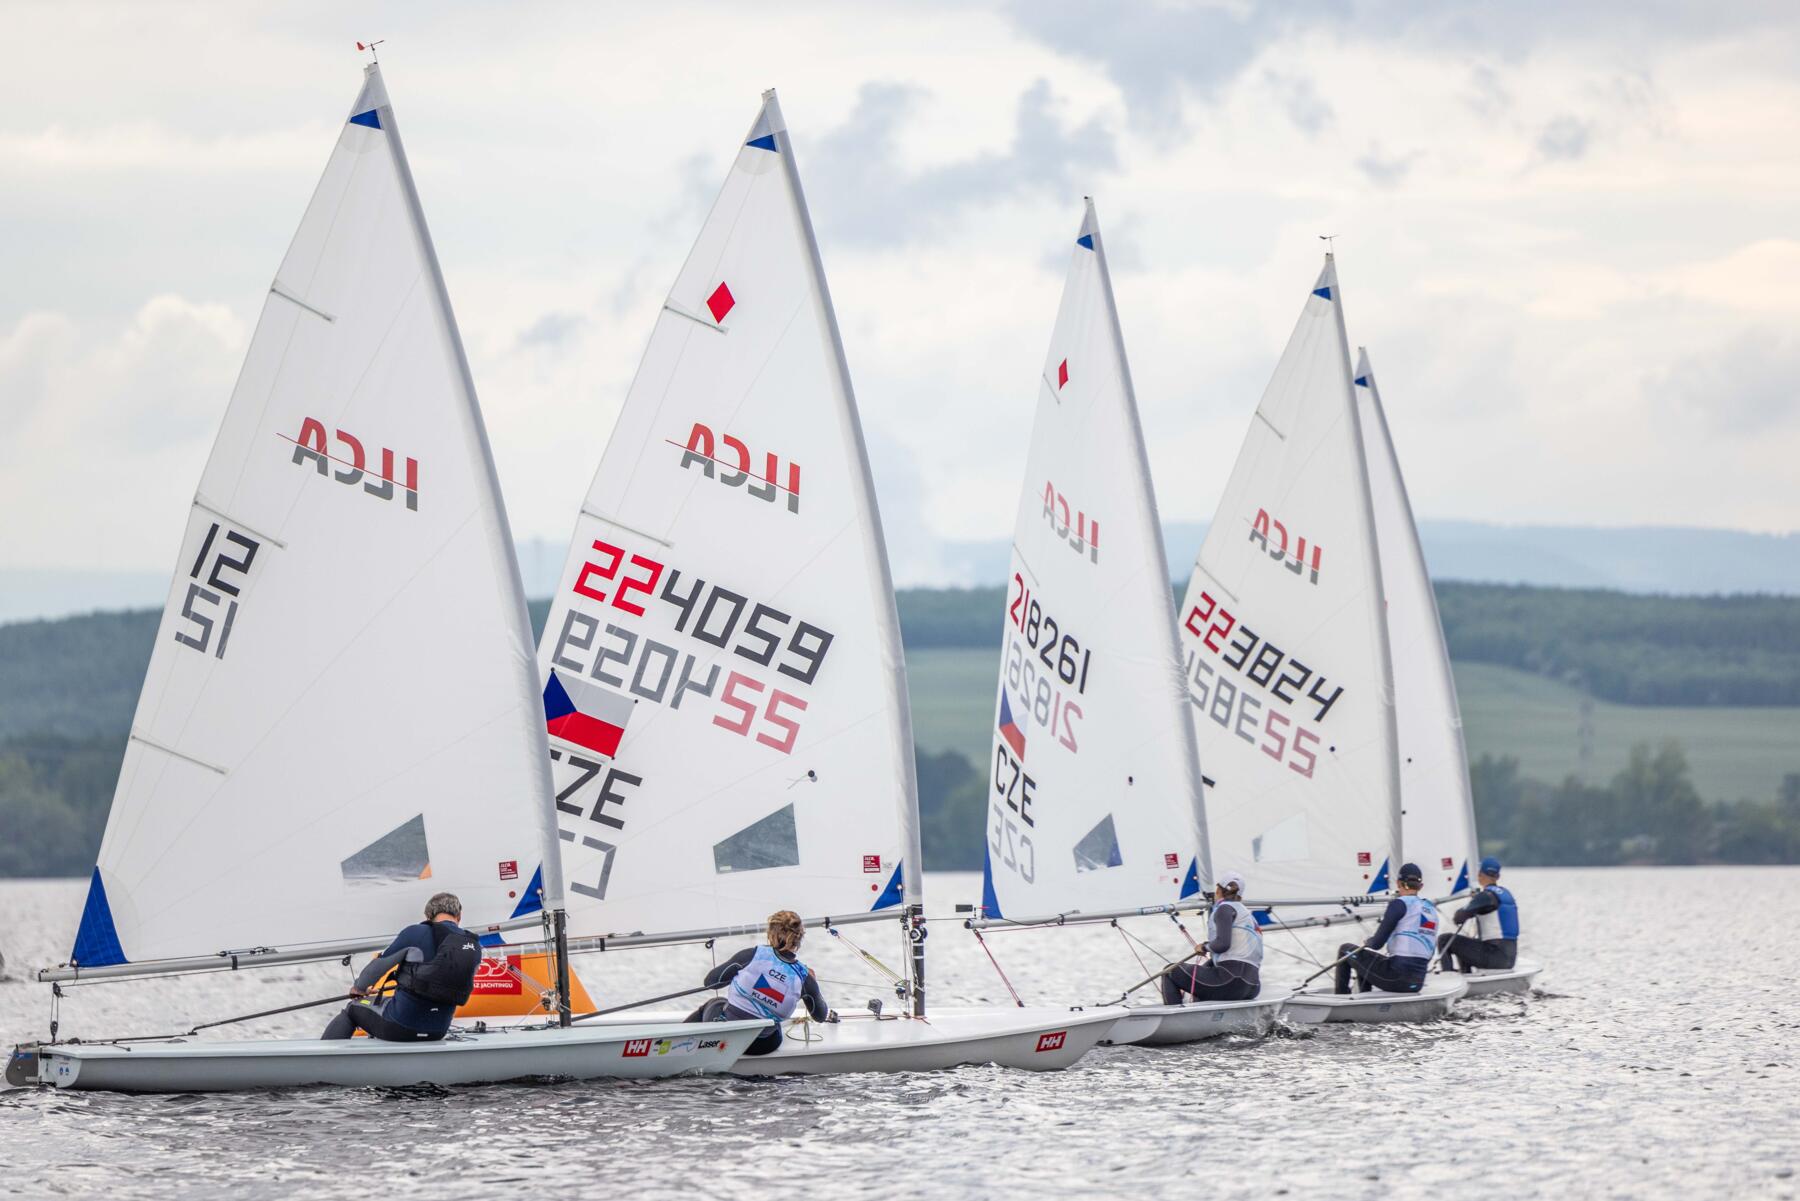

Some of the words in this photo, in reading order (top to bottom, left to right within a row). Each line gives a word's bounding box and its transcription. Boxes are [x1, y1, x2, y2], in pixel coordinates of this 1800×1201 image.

[190, 522, 260, 597] 12
[572, 539, 834, 686] 224059
[1010, 572, 1091, 695] 218261
[1185, 591, 1345, 723] 223824
[549, 749, 643, 831] ZE
[995, 744, 1036, 828] CZE
[480, 982, 513, 990] JACHTINGU
[768, 969, 787, 983] CZE
[751, 991, 778, 1009] KLARA
[626, 1039, 649, 1054] HH
[698, 1039, 720, 1050] Laser
[1040, 1035, 1062, 1049] HH
